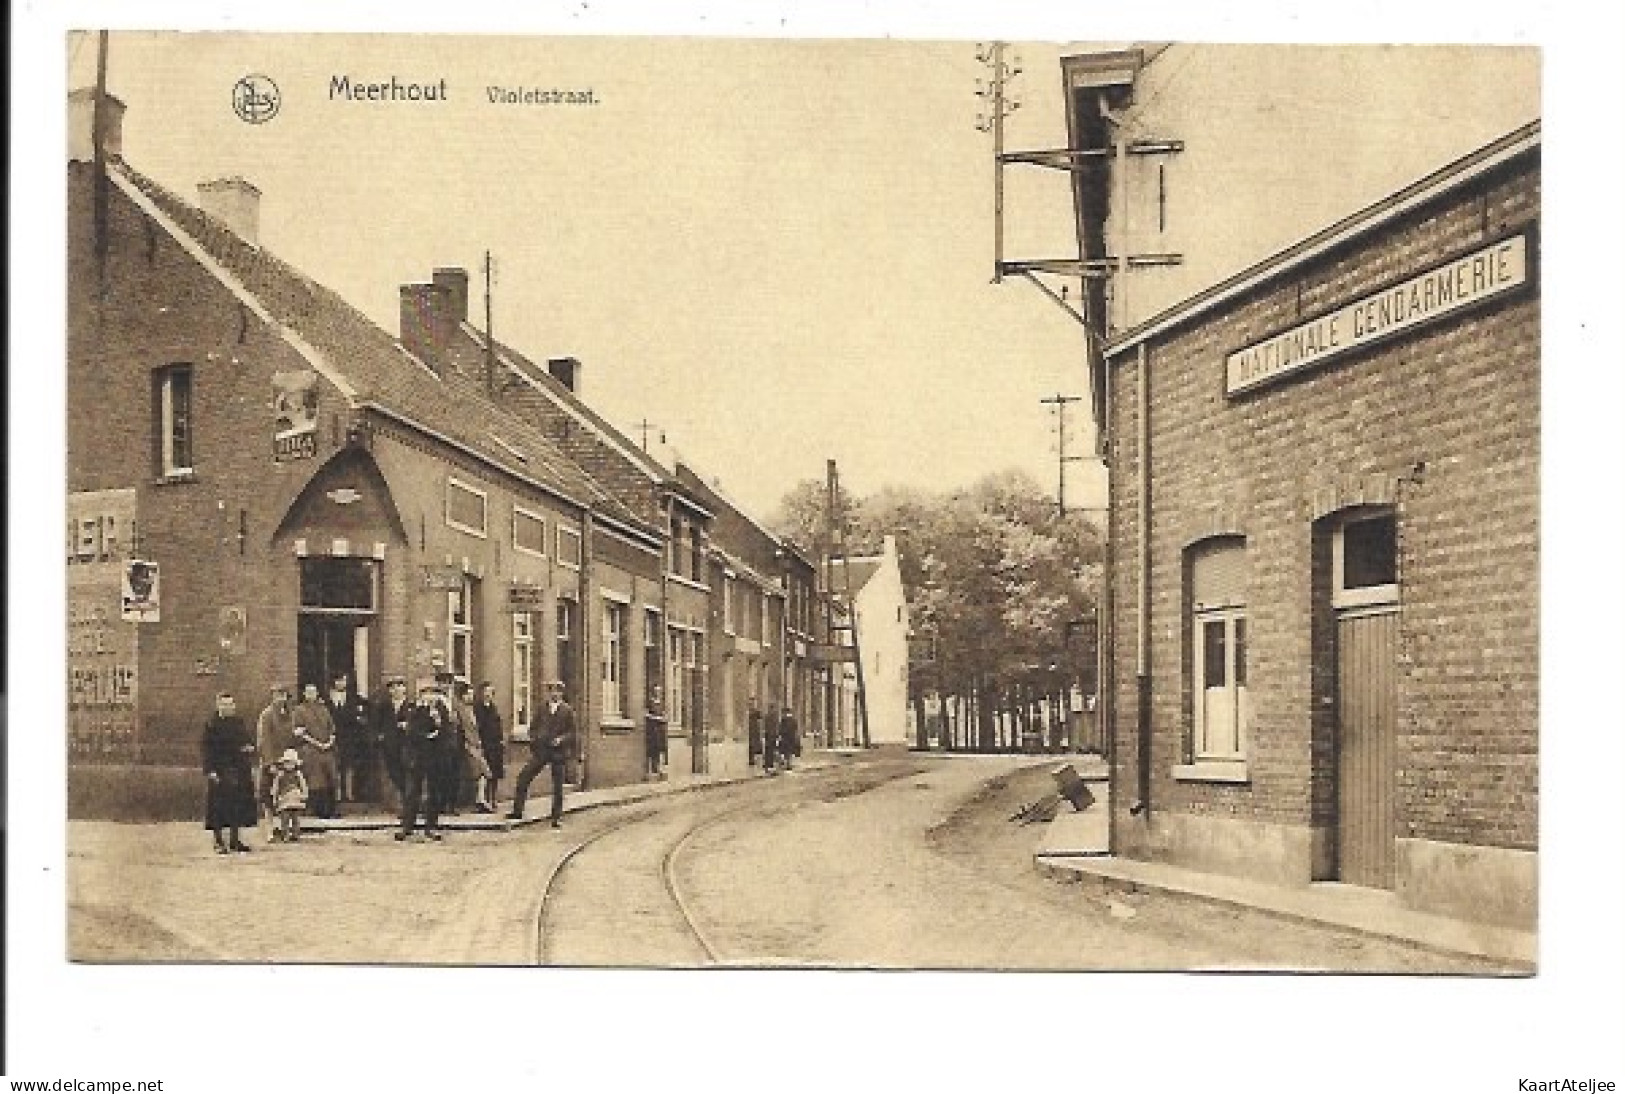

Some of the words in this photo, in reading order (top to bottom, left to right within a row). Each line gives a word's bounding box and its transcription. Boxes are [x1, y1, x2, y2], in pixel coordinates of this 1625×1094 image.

[328, 75, 448, 102] Meerhout
[486, 86, 601, 105] Violetstraat.
[1238, 314, 1341, 384] NATIONALE
[1353, 242, 1513, 341] GENDARMERIE
